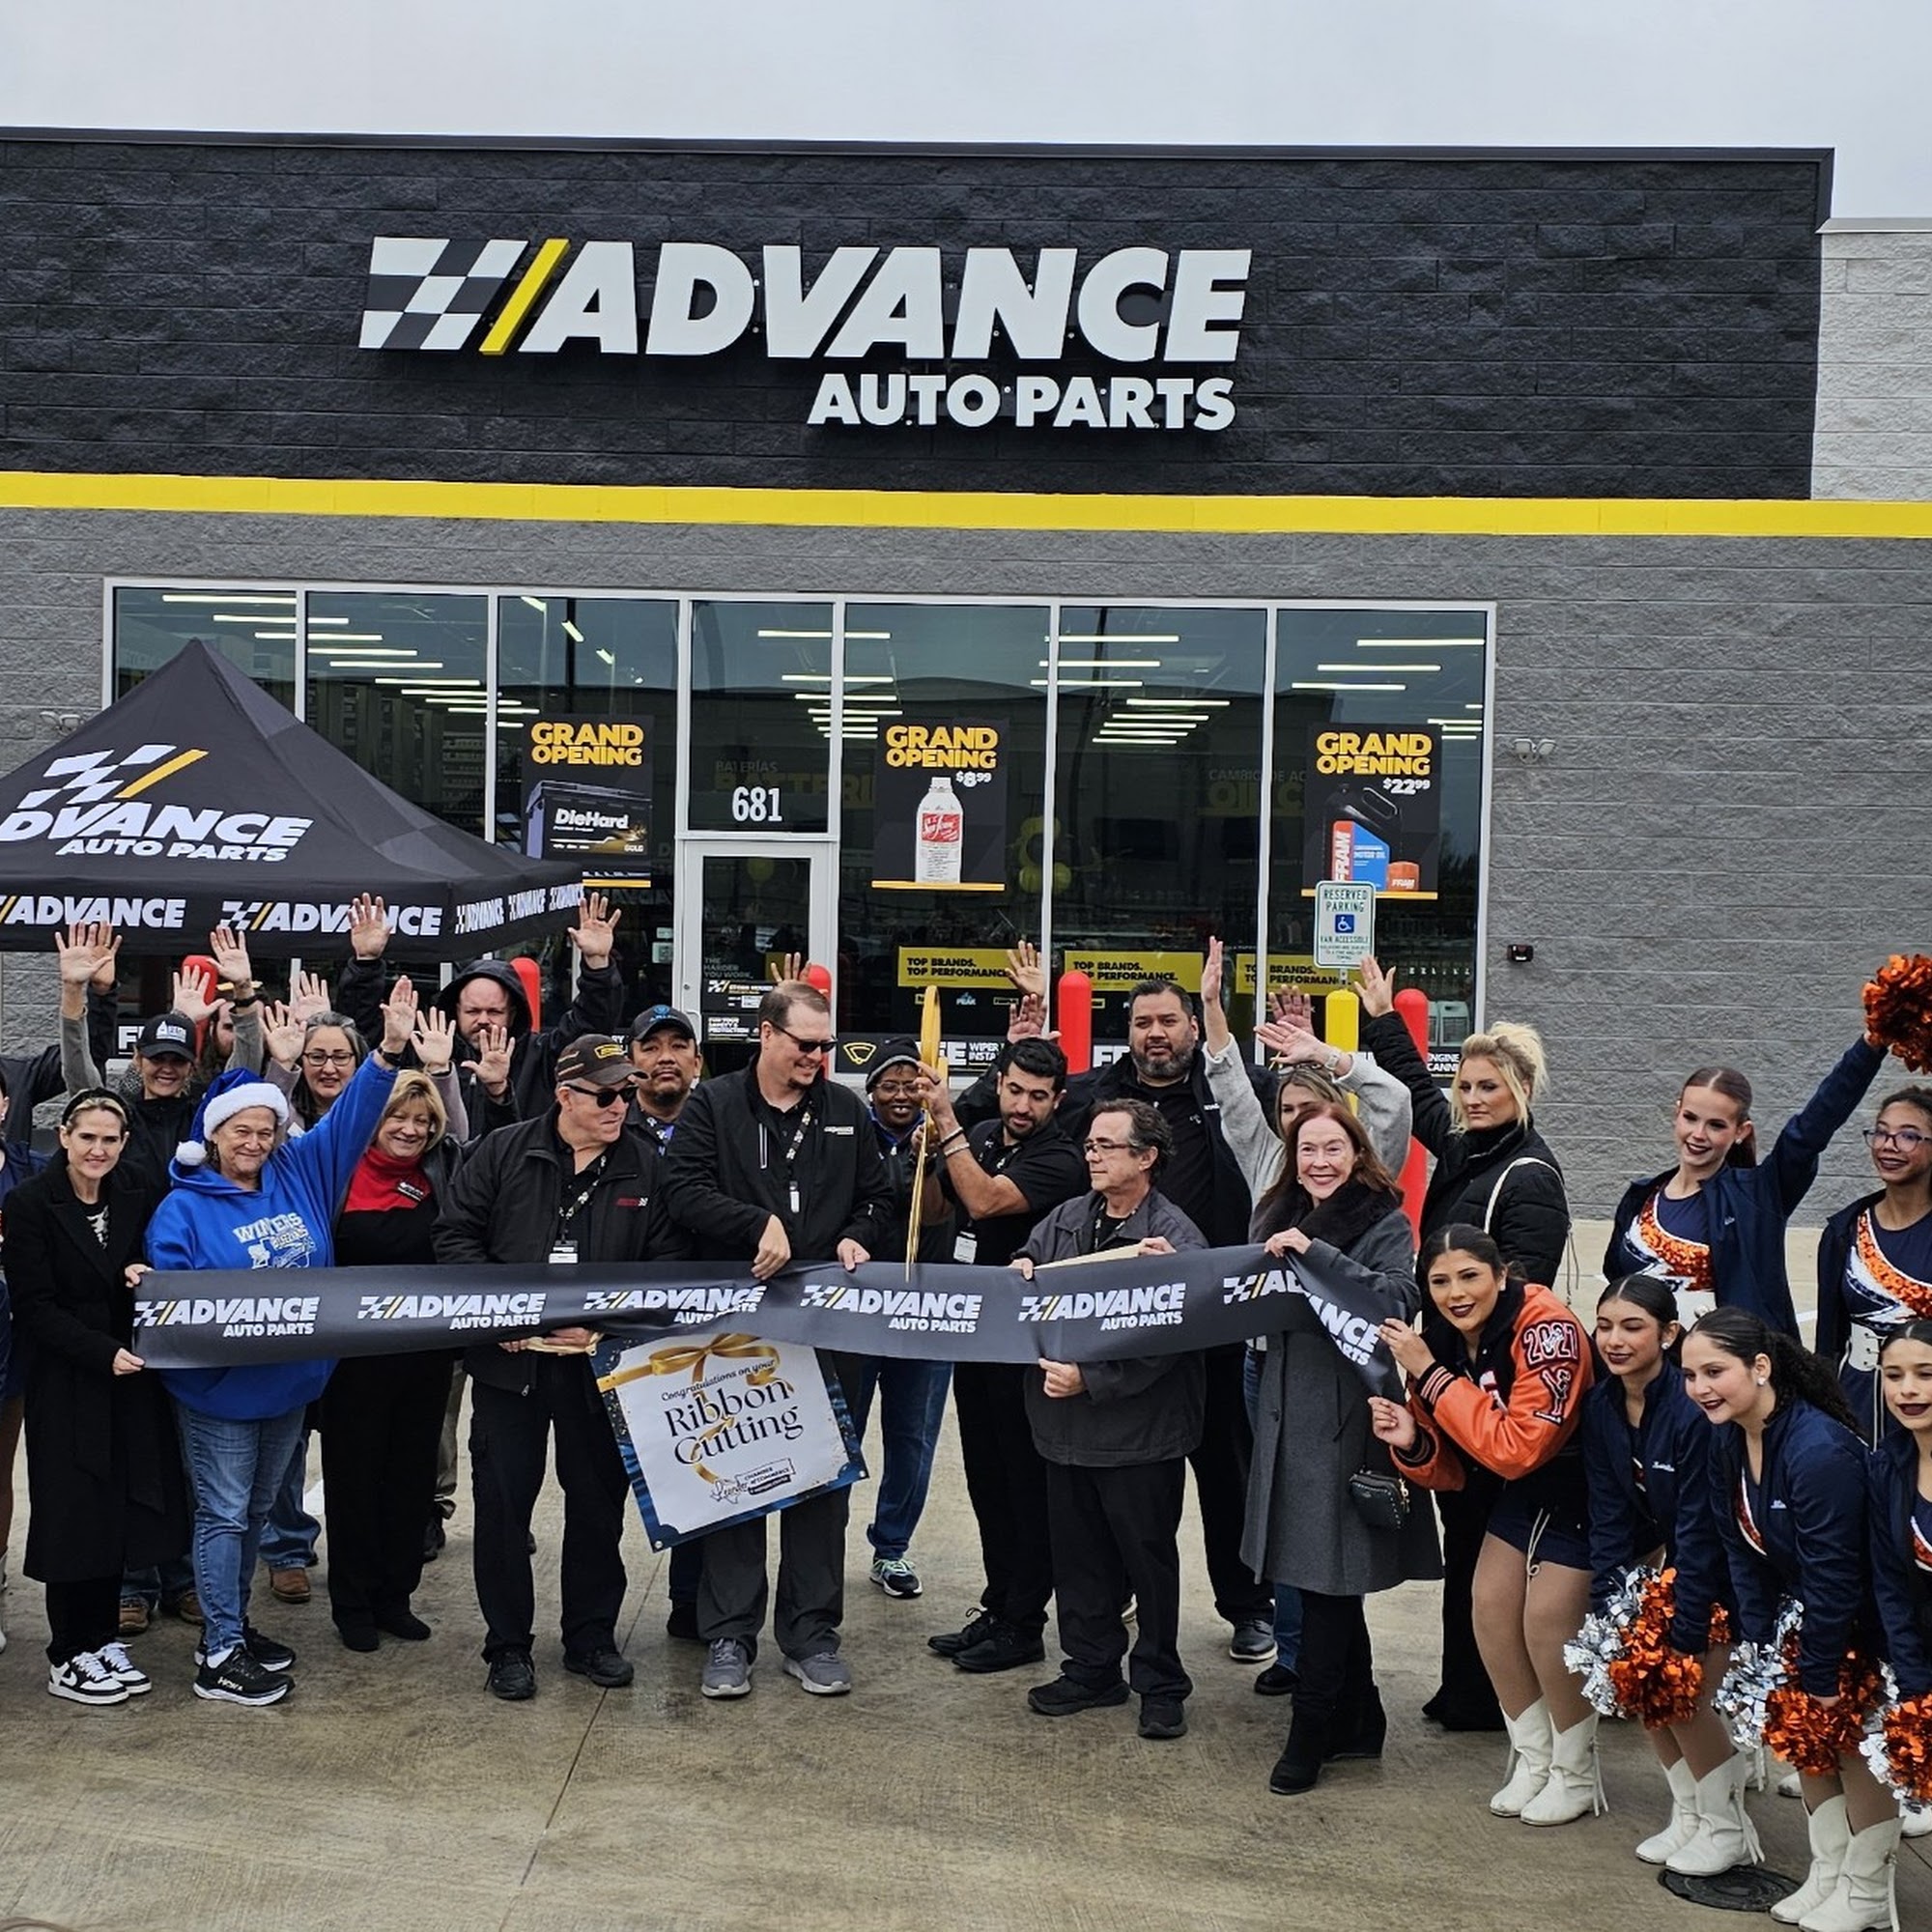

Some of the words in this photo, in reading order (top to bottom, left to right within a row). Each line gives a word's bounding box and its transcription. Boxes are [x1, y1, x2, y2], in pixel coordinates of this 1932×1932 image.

[518, 241, 1253, 362] ADVANCE
[807, 373, 1001, 427] AUTO
[1015, 376, 1236, 431] PARTS
[531, 722, 644, 747] GRAND
[886, 725, 999, 750] GRAND
[1316, 732, 1433, 756] GRAND
[531, 745, 642, 766] OPENING
[886, 749, 997, 769] OPENING
[1317, 755, 1431, 776] OPENING
[732, 785, 782, 822] 681
[554, 809, 629, 830] DieHard
[55, 838, 163, 856] AUTO
[166, 841, 290, 862] PARTS
[1323, 889, 1369, 900] RESERVED
[1391, 878, 1416, 890] FRAM
[4, 896, 186, 928] ADVANCE
[1326, 901, 1365, 912] PARKING
[907, 957, 928, 967] TOP
[931, 957, 977, 968] BRANDS.
[907, 967, 928, 977] TOP
[1073, 961, 1094, 971] TOP
[1097, 962, 1144, 971] BRANDS.
[1269, 966, 1317, 975] BRANDS.
[1097, 972, 1179, 981] PERFORMANCE.
[1269, 975, 1352, 985] PERFORMAN.
[969, 1042, 999, 1053] WIPER
[393, 1293, 547, 1319] ADVANCE
[619, 1286, 767, 1312] ADVANCE
[832, 1288, 983, 1320] ADVANCE
[1049, 1283, 1187, 1321] ADVANCE
[164, 1296, 320, 1325] ADVANCE
[449, 1316, 493, 1329] AUTO
[493, 1313, 541, 1327] PARTS
[1100, 1316, 1138, 1331] AUTO
[1138, 1311, 1183, 1326] PARTS
[223, 1323, 265, 1338] AUTO
[266, 1322, 314, 1337] PARTS
[889, 1317, 929, 1331] AUTO
[929, 1319, 978, 1333] PARTS
[661, 1368, 737, 1402] Congratulations
[737, 1366, 753, 1378] on
[752, 1359, 776, 1376] your
[664, 1379, 791, 1436] Ribbon
[674, 1406, 804, 1464] Cutting
